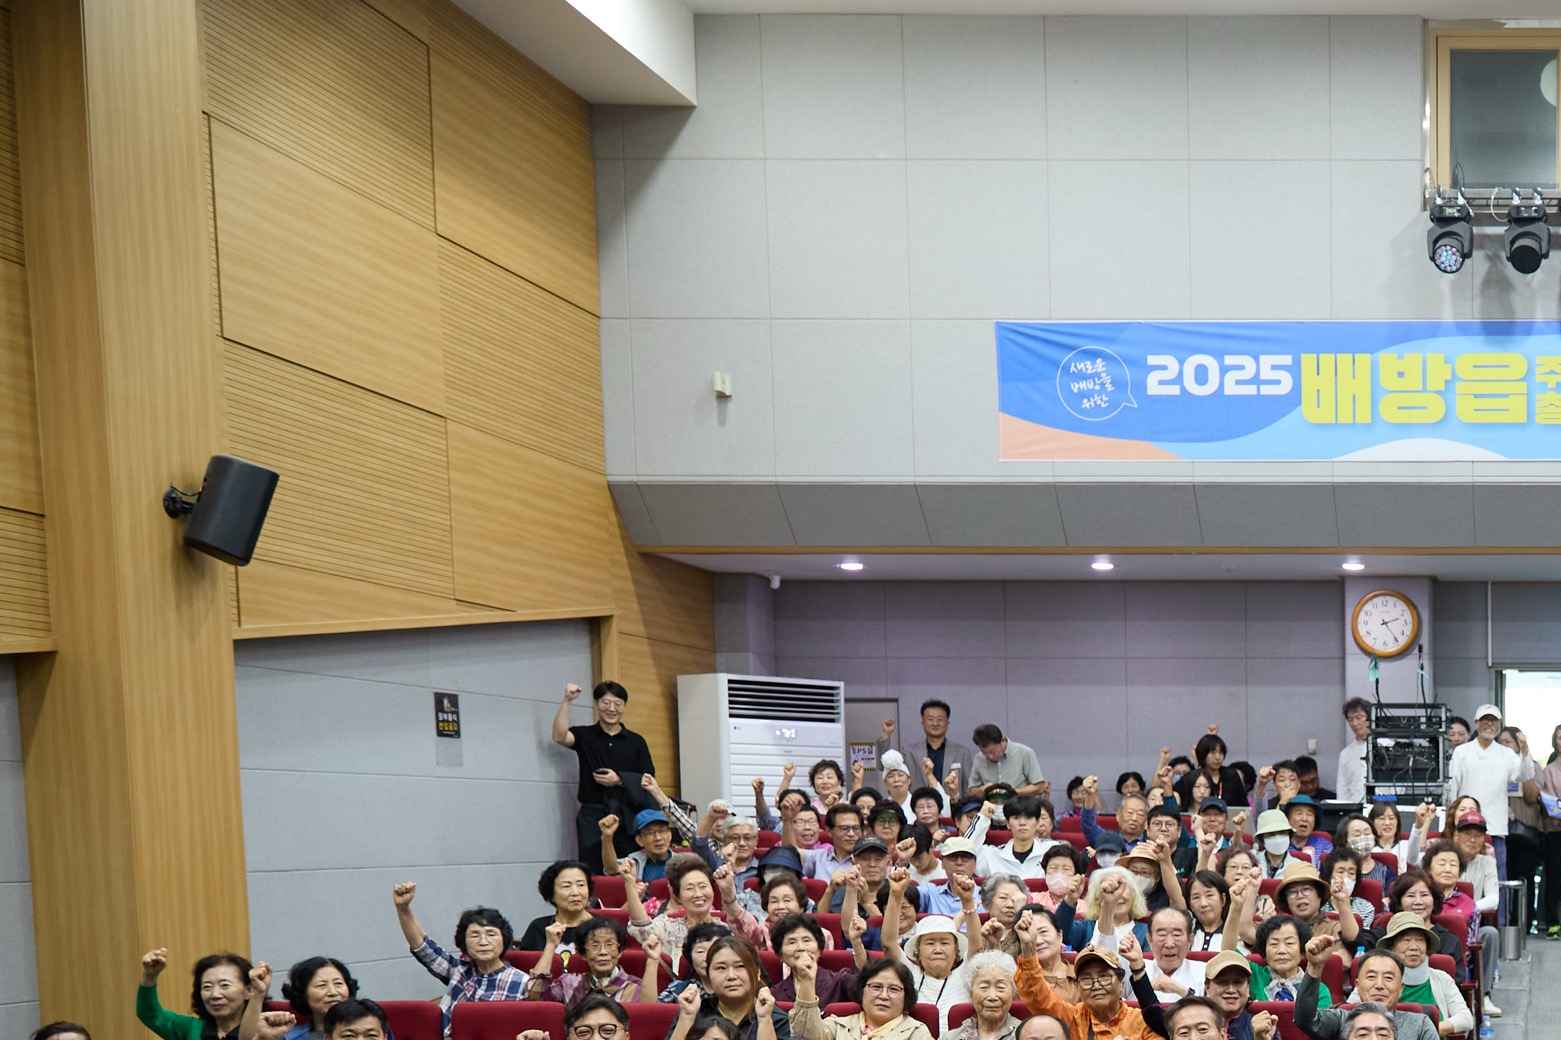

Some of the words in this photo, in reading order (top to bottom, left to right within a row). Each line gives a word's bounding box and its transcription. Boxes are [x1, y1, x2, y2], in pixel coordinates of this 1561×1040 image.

[1070, 357, 1107, 374] 새로운
[1145, 354, 1293, 396] 2025
[1081, 393, 1110, 409] 위한
[1301, 352, 1529, 425] 배방읍
